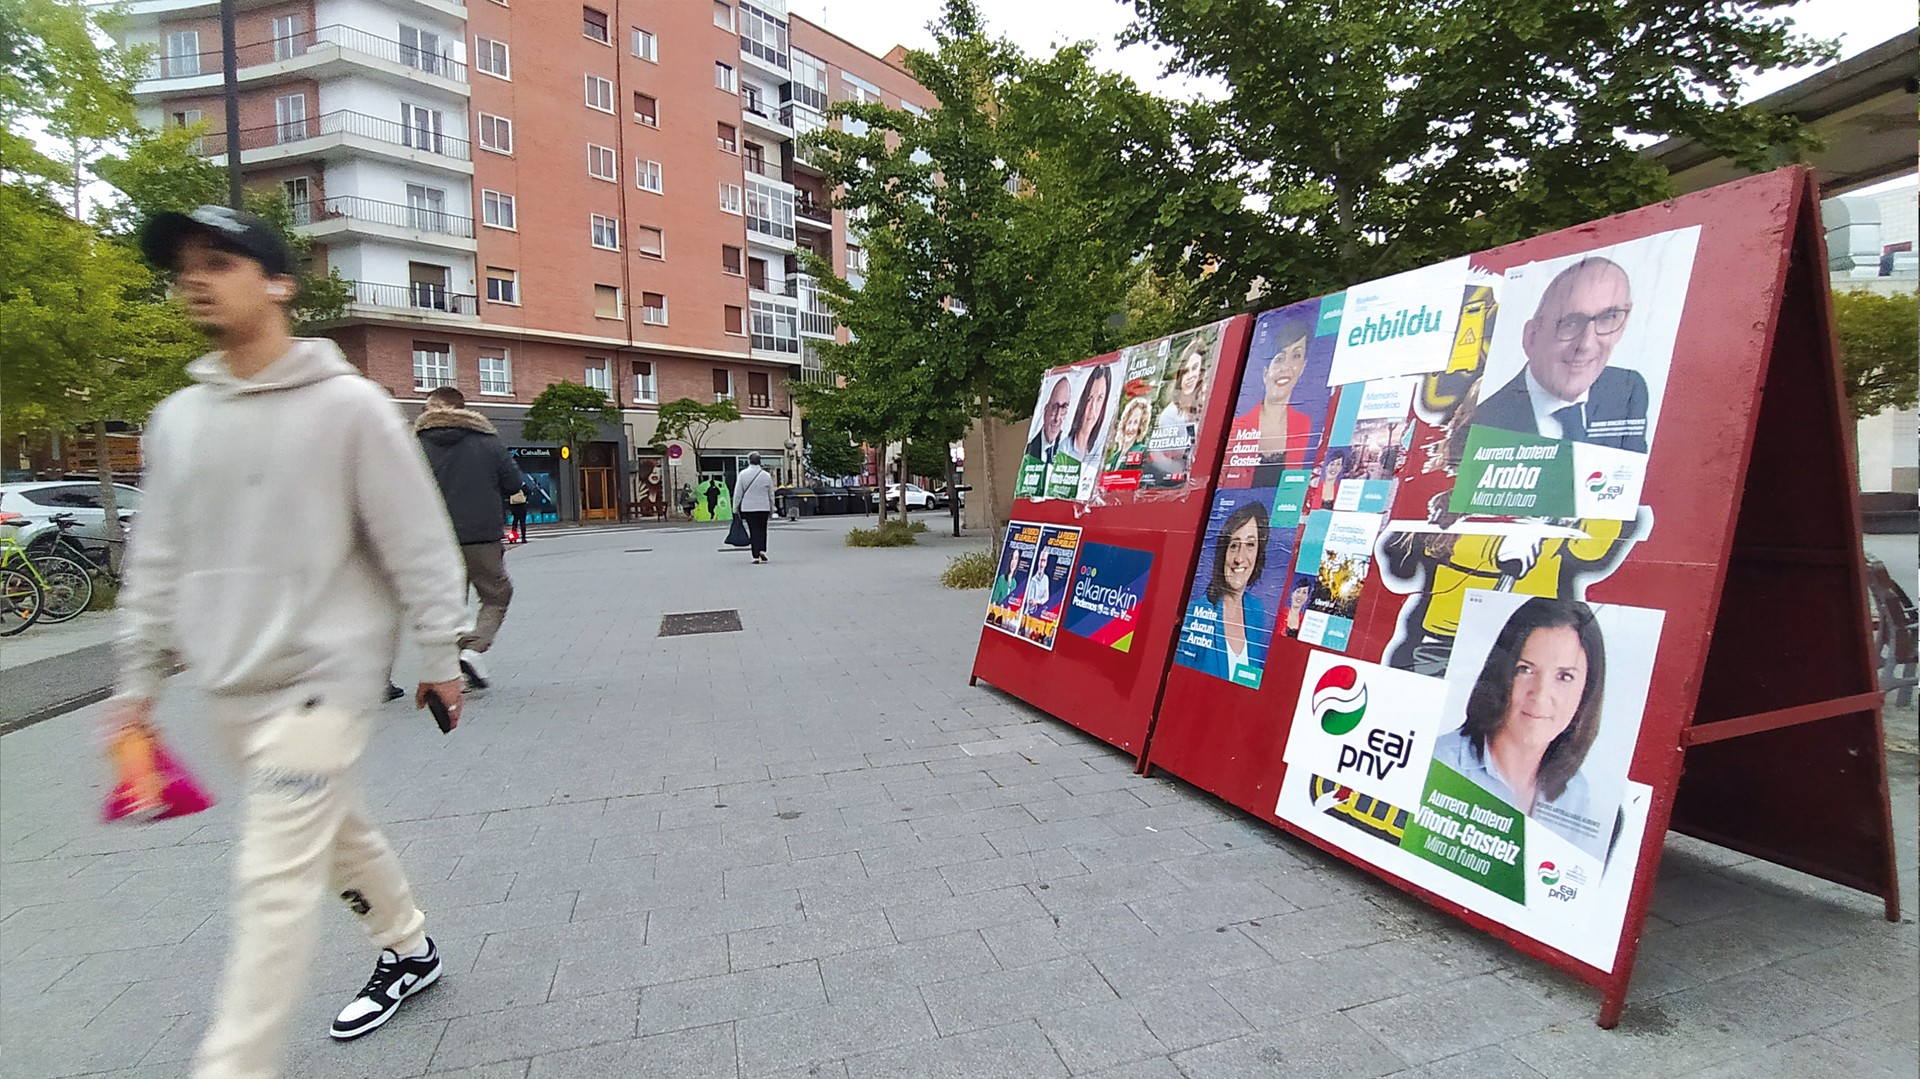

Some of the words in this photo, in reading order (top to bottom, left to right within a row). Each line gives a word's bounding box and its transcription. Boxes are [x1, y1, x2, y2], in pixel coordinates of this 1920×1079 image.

[1348, 305, 1443, 347] ehbildu
[1151, 426, 1179, 439] MAIDER
[1235, 428, 1262, 440] Maite
[1148, 436, 1191, 449] ETXEBARRIA
[1232, 443, 1259, 454] duzun
[520, 448, 551, 456] CaixaBank
[1474, 446, 1514, 461] Aurrera,
[1516, 444, 1559, 460] batera!
[1229, 455, 1262, 466] Gasteiz
[1477, 463, 1542, 489] Araba
[1607, 484, 1624, 497] eaj
[1470, 491, 1493, 506] Mira
[1493, 492, 1503, 506] al
[1502, 491, 1537, 508] futuro
[1597, 492, 1617, 506] pnv
[1075, 577, 1138, 612] elkarrekin
[1072, 595, 1098, 612] Podemos
[1193, 605, 1218, 621] Maite
[1190, 619, 1215, 635] duzun
[1186, 632, 1213, 649] Araba
[1368, 728, 1416, 768] eaj
[1337, 744, 1395, 780] pnv
[1427, 789, 1469, 819] Aurrera,
[1469, 803, 1514, 834] batera!
[1413, 803, 1520, 866] Vitoria-Gasteiz
[1423, 834, 1446, 856] Mira
[1446, 843, 1459, 861] al
[1458, 847, 1491, 876] futuro
[1548, 888, 1571, 902] pnv
[1560, 885, 1578, 900] eaj
